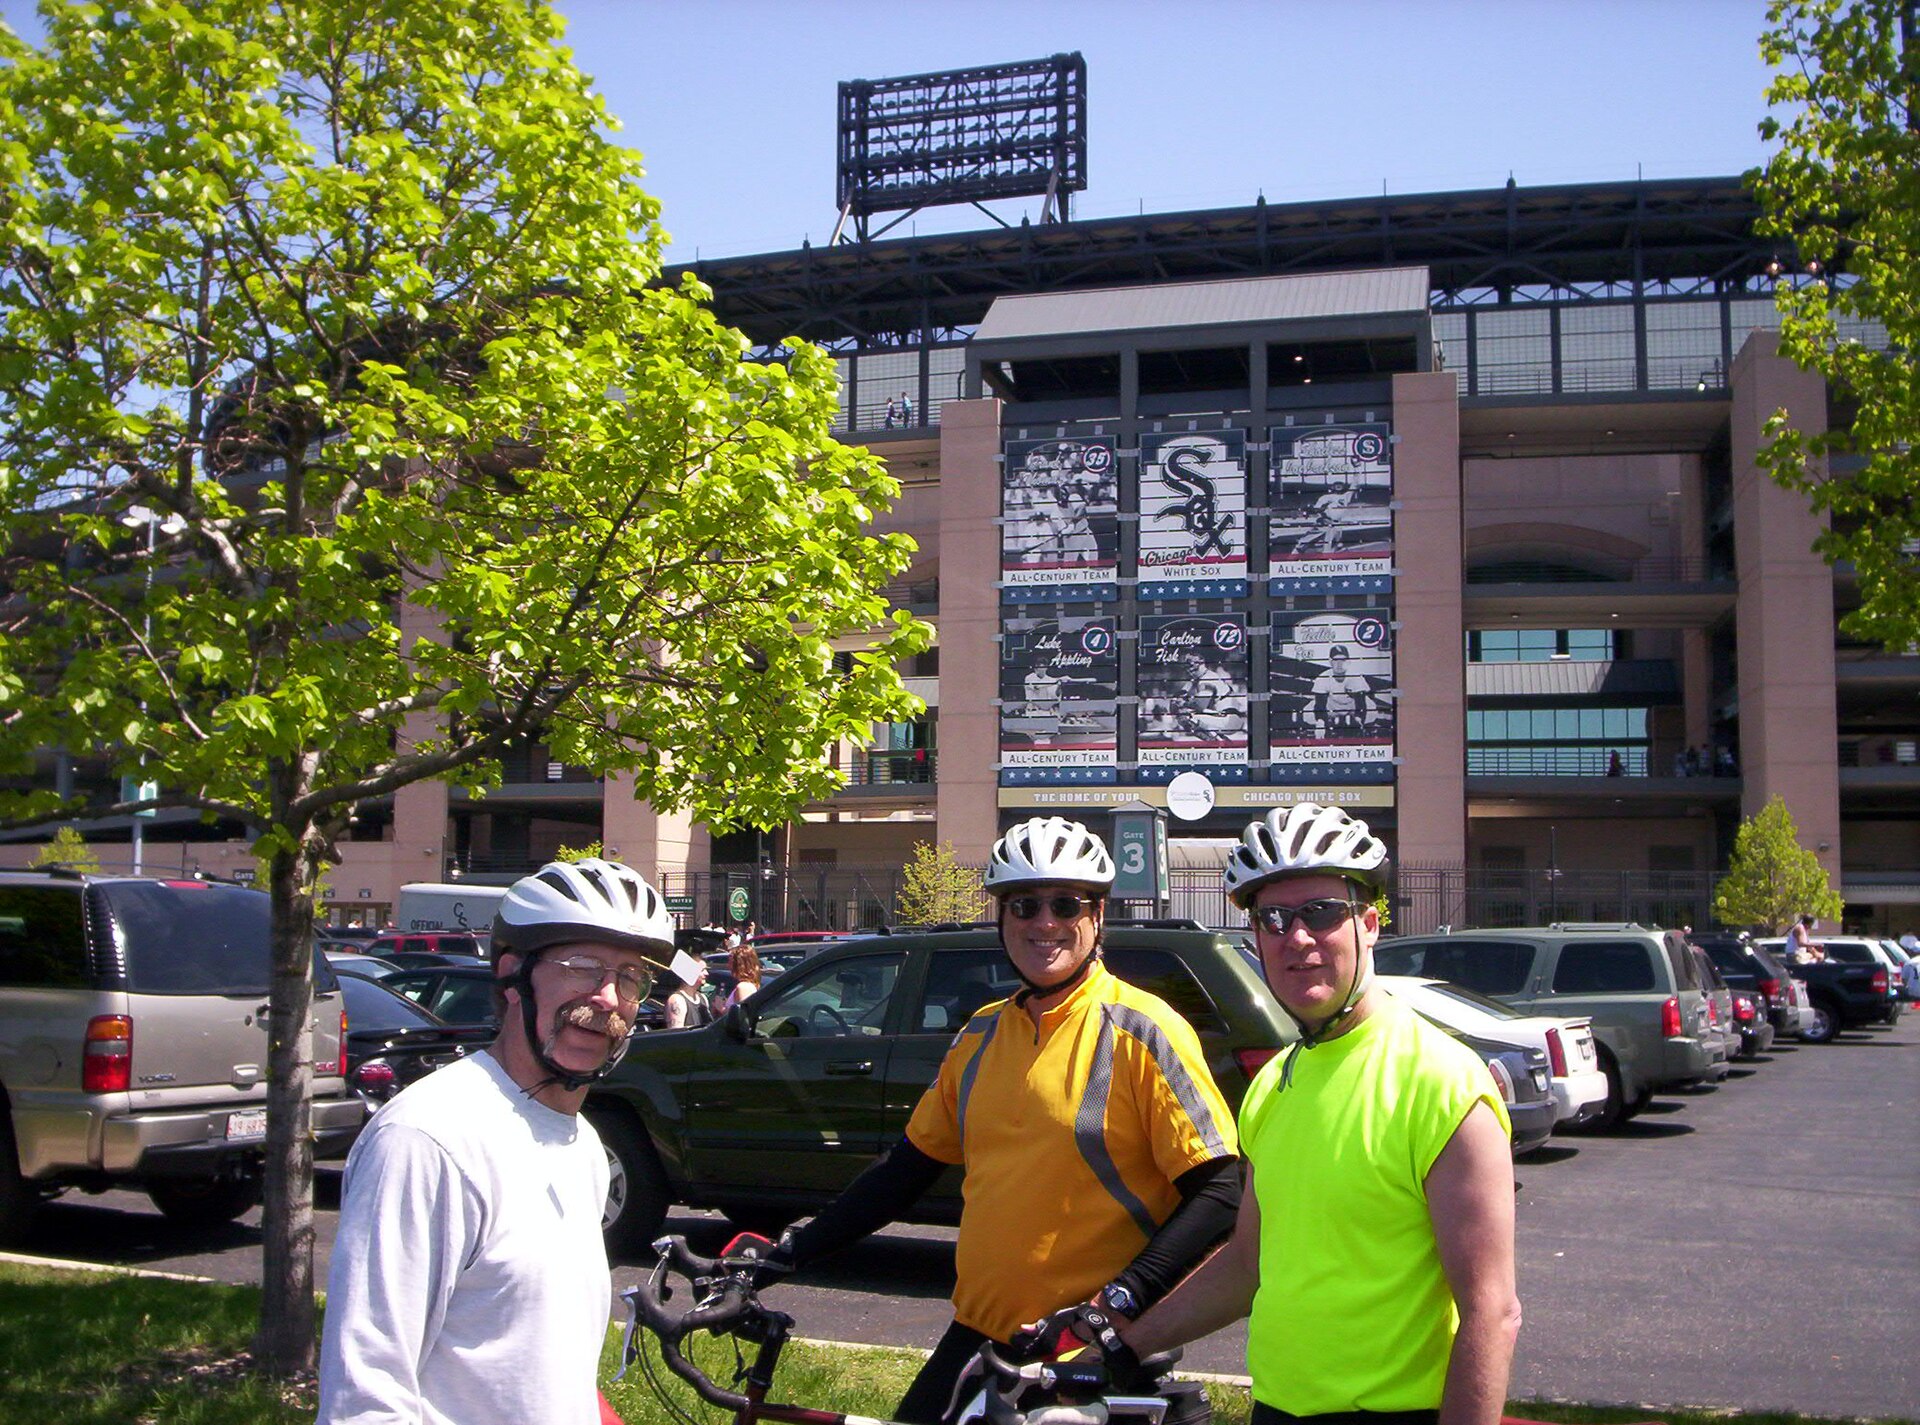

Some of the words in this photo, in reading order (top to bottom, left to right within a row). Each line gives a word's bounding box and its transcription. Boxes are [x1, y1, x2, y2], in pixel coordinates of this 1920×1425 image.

[1362, 439, 1375, 454] S
[1086, 452, 1106, 466] 35
[1145, 549, 1193, 567] Chicago
[1163, 566, 1196, 576] WHITE
[1200, 566, 1221, 576] SOX
[1278, 563, 1350, 574] ALL-CENTURY
[1354, 562, 1384, 572] TEAM
[1010, 571, 1078, 582] ALL-CENTURY
[1083, 570, 1110, 580] TEAM
[1161, 630, 1202, 646] Carlton
[1218, 629, 1239, 643] 72
[1362, 625, 1375, 639] 2
[1034, 634, 1062, 649] Luke
[1090, 634, 1102, 647] 4
[1050, 652, 1092, 667] Appling
[1155, 648, 1180, 663] Fisk
[1009, 753, 1077, 763] ALL-CENTURY
[1082, 753, 1110, 762] TEAM
[1141, 751, 1212, 761] ALL-CENTURY
[1216, 751, 1245, 760] TEAM
[1278, 749, 1351, 759] ALL-CENTURY
[1356, 749, 1386, 758] TEAM
[1033, 793, 1056, 802] THE
[1059, 793, 1091, 802] HOME
[1094, 793, 1107, 802] OF
[1112, 793, 1140, 802] YOUR
[1243, 792, 1292, 802] CHICAGO
[1296, 792, 1335, 802] WHITE
[1339, 792, 1361, 801] SOX
[1122, 842, 1145, 874] 3
[234, 872, 254, 880] GATE
